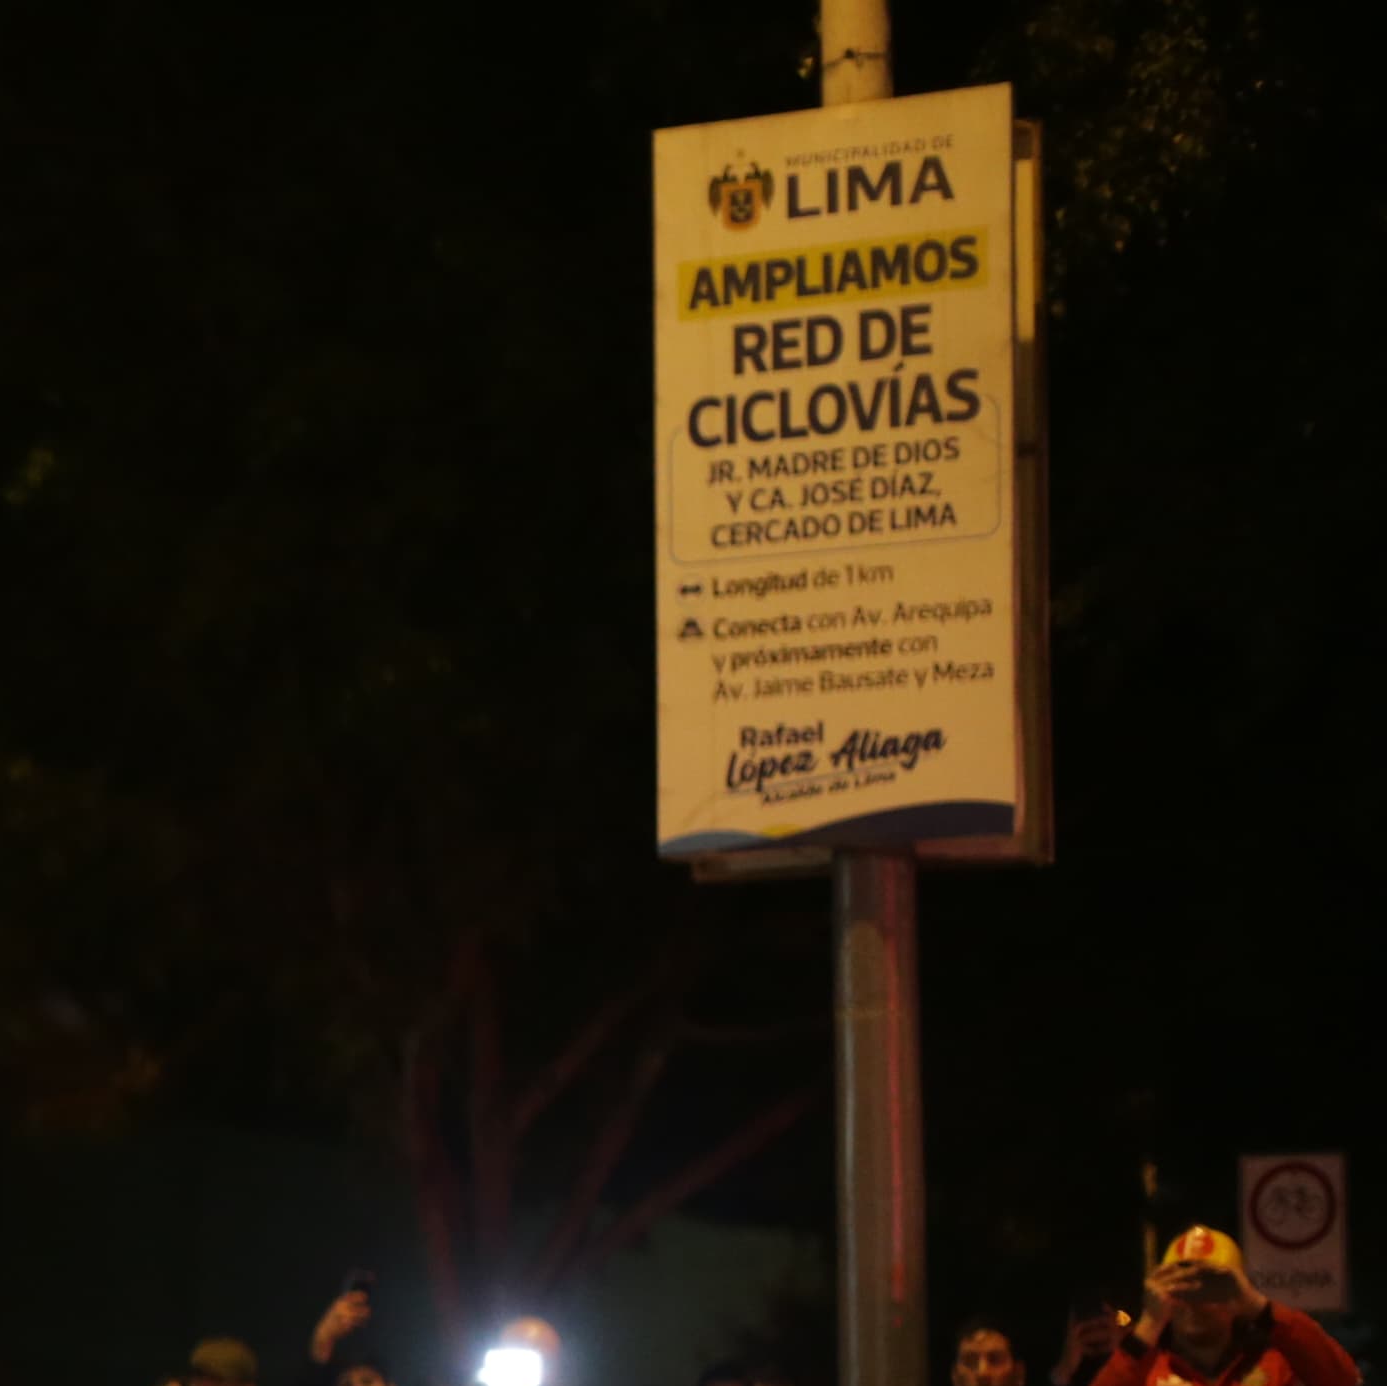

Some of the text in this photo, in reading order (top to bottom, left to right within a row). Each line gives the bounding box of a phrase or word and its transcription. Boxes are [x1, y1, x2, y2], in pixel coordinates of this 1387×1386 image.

[785, 134, 954, 166] MUNICIPALIDAD DE
[787, 155, 955, 219] LIMA
[688, 235, 980, 310] AMPLIAMOS
[734, 303, 932, 375] RED DE
[688, 362, 981, 448] CICLOVÍAS
[707, 436, 960, 485] JR. MADRE DE DIOS
[725, 491, 743, 514] Y
[750, 487, 793, 511] CA.
[801, 475, 863, 507] JOSÉ
[711, 502, 957, 548] CERCADO DE LIMA
[712, 569, 808, 598] Longitud
[812, 568, 839, 588] de
[713, 615, 802, 638] Conecta
[807, 611, 847, 630] con
[893, 597, 993, 623] Arequipa
[712, 634, 939, 673] y próximamente con
[754, 677, 813, 698] Jaime
[819, 668, 909, 693] Bausate
[914, 669, 928, 688] y
[933, 661, 995, 682] Meza
[740, 720, 824, 748] Rafael
[829, 728, 947, 771] Aliaga
